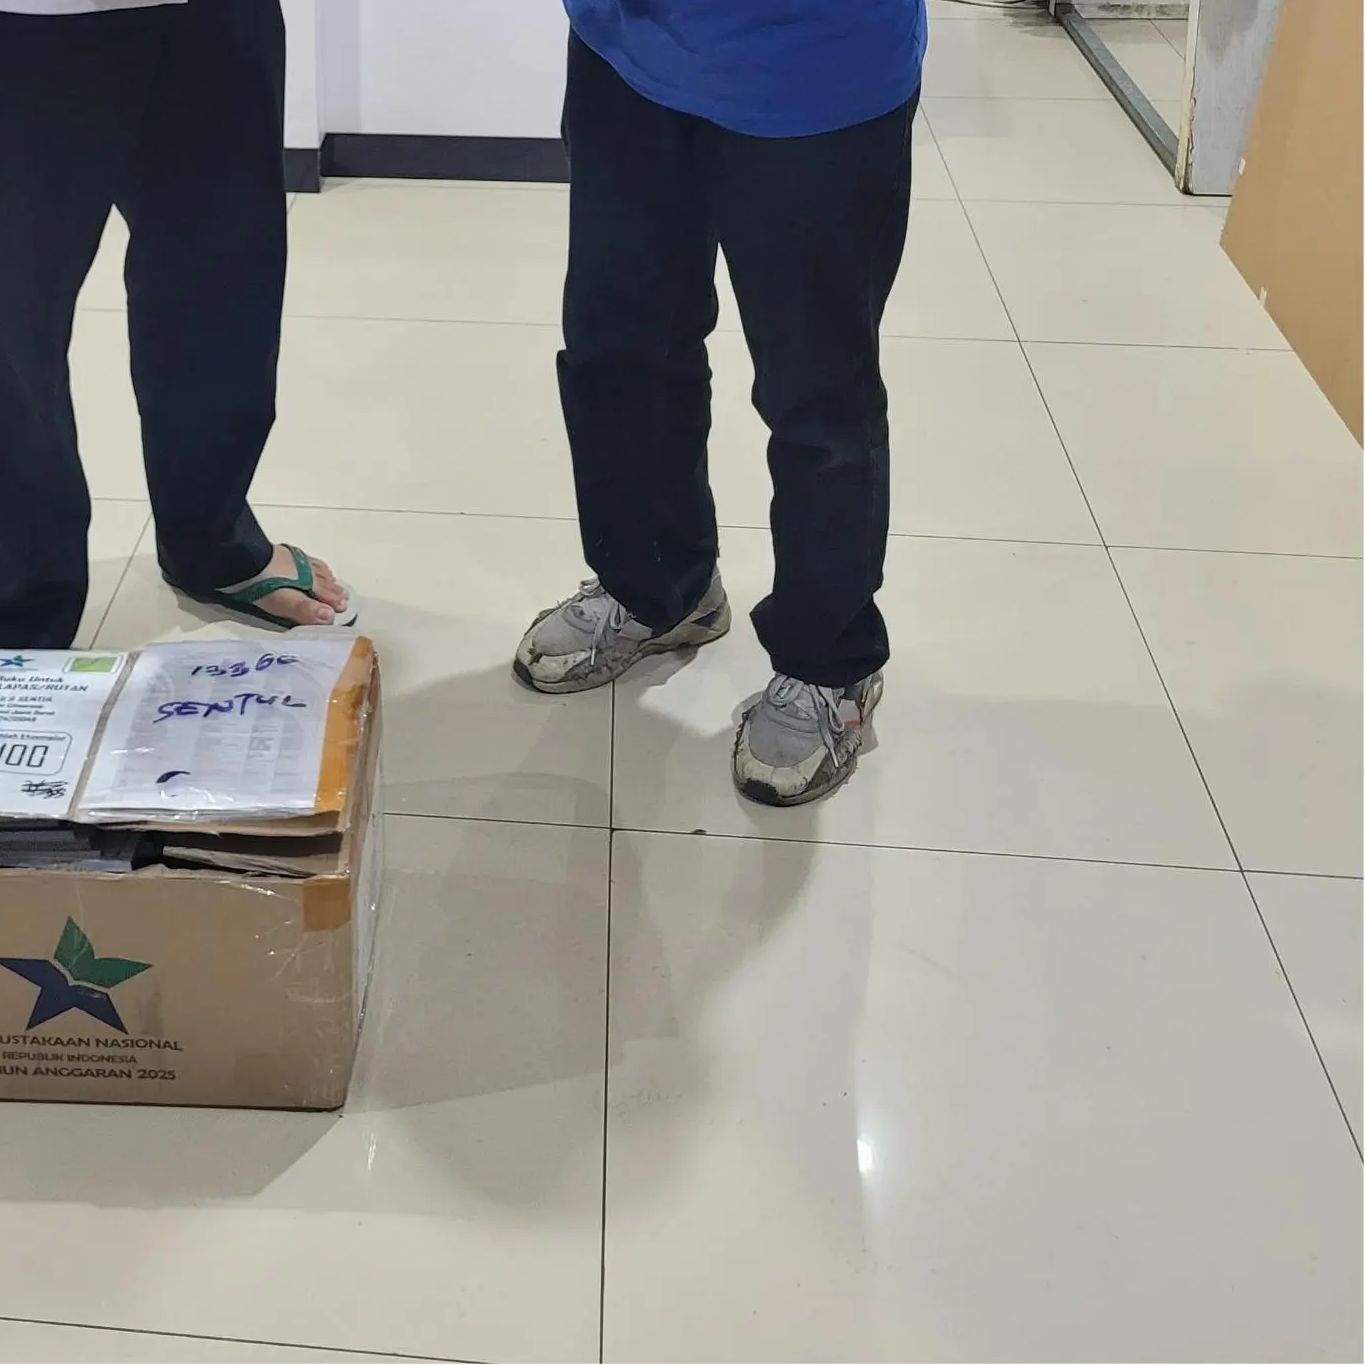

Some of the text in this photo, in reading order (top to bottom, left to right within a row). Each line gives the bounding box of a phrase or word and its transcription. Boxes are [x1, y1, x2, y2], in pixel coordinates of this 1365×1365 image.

[153, 693, 306, 723] SENTUL
[95, 1037, 183, 1052] NASIONAL
[2, 1051, 137, 1064] REPUBLIK INDONESIA
[32, 1067, 132, 1079] ANGGARAN
[137, 1069, 176, 1080] 2025
